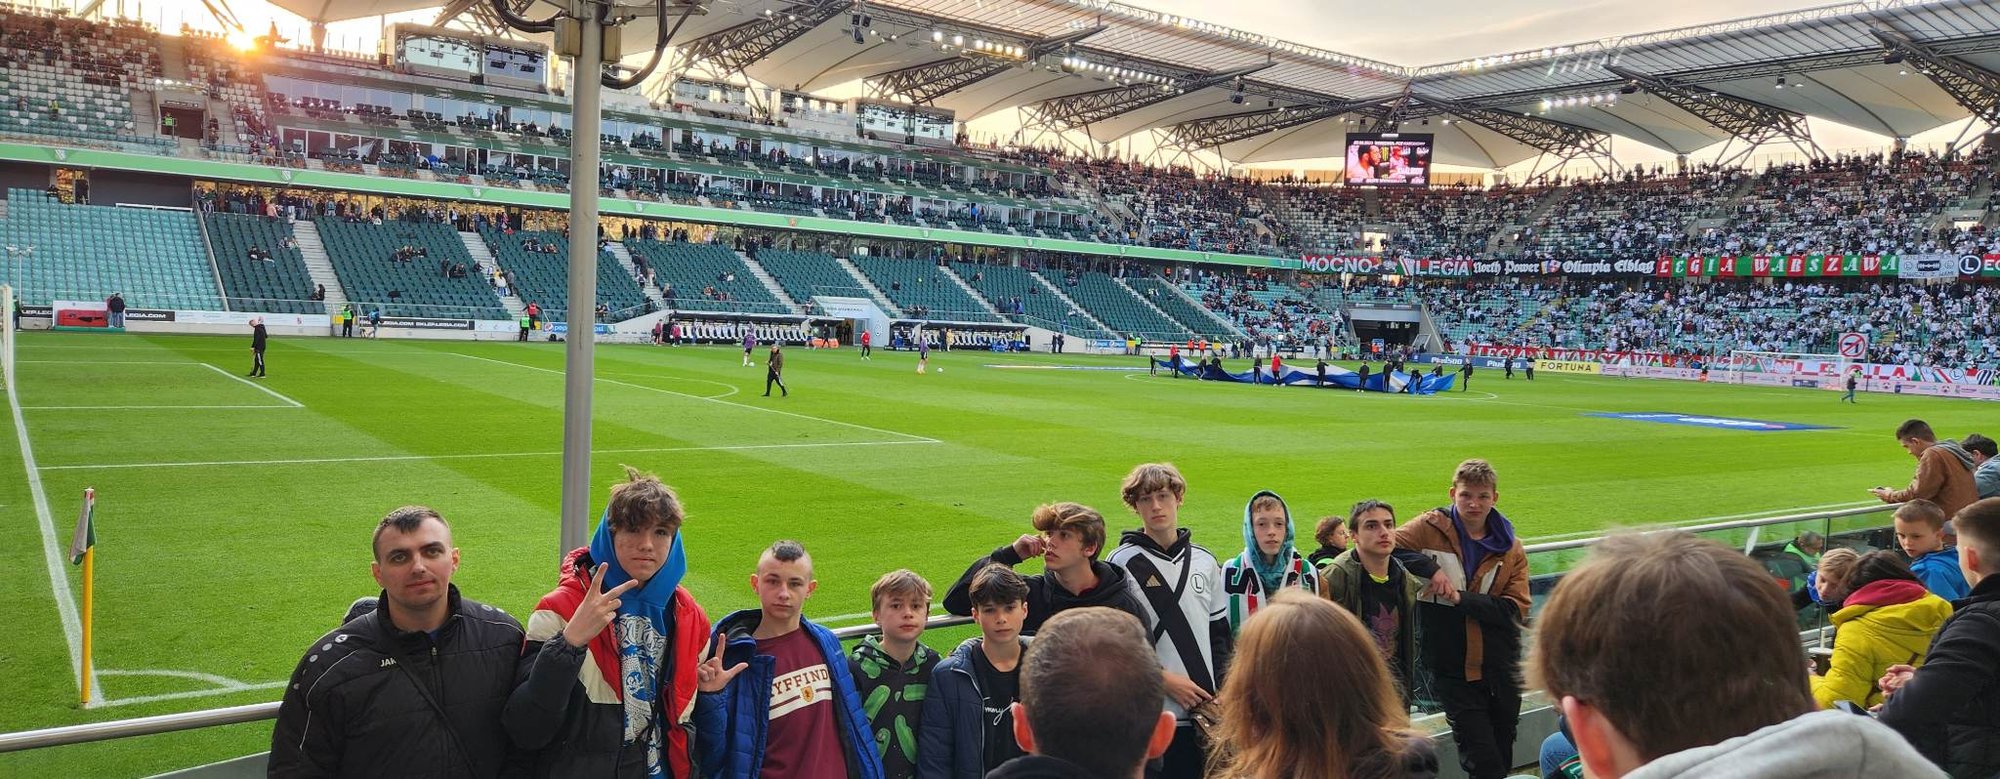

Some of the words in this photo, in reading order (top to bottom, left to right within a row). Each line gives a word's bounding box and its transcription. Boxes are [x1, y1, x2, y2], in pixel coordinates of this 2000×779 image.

[1302, 255, 1372, 273] MOCNO
[1416, 258, 1470, 276] LEGIA
[1473, 261, 1501, 275] North
[1504, 260, 1540, 275] Power
[1562, 260, 1611, 275] Olimpia
[1659, 257, 1735, 274] LEGIA
[1753, 256, 1897, 274] WARSZAWA
[1541, 361, 1592, 372] FORTUNA
[380, 657, 397, 668] JAK
[772, 668, 828, 695] YFFIND
